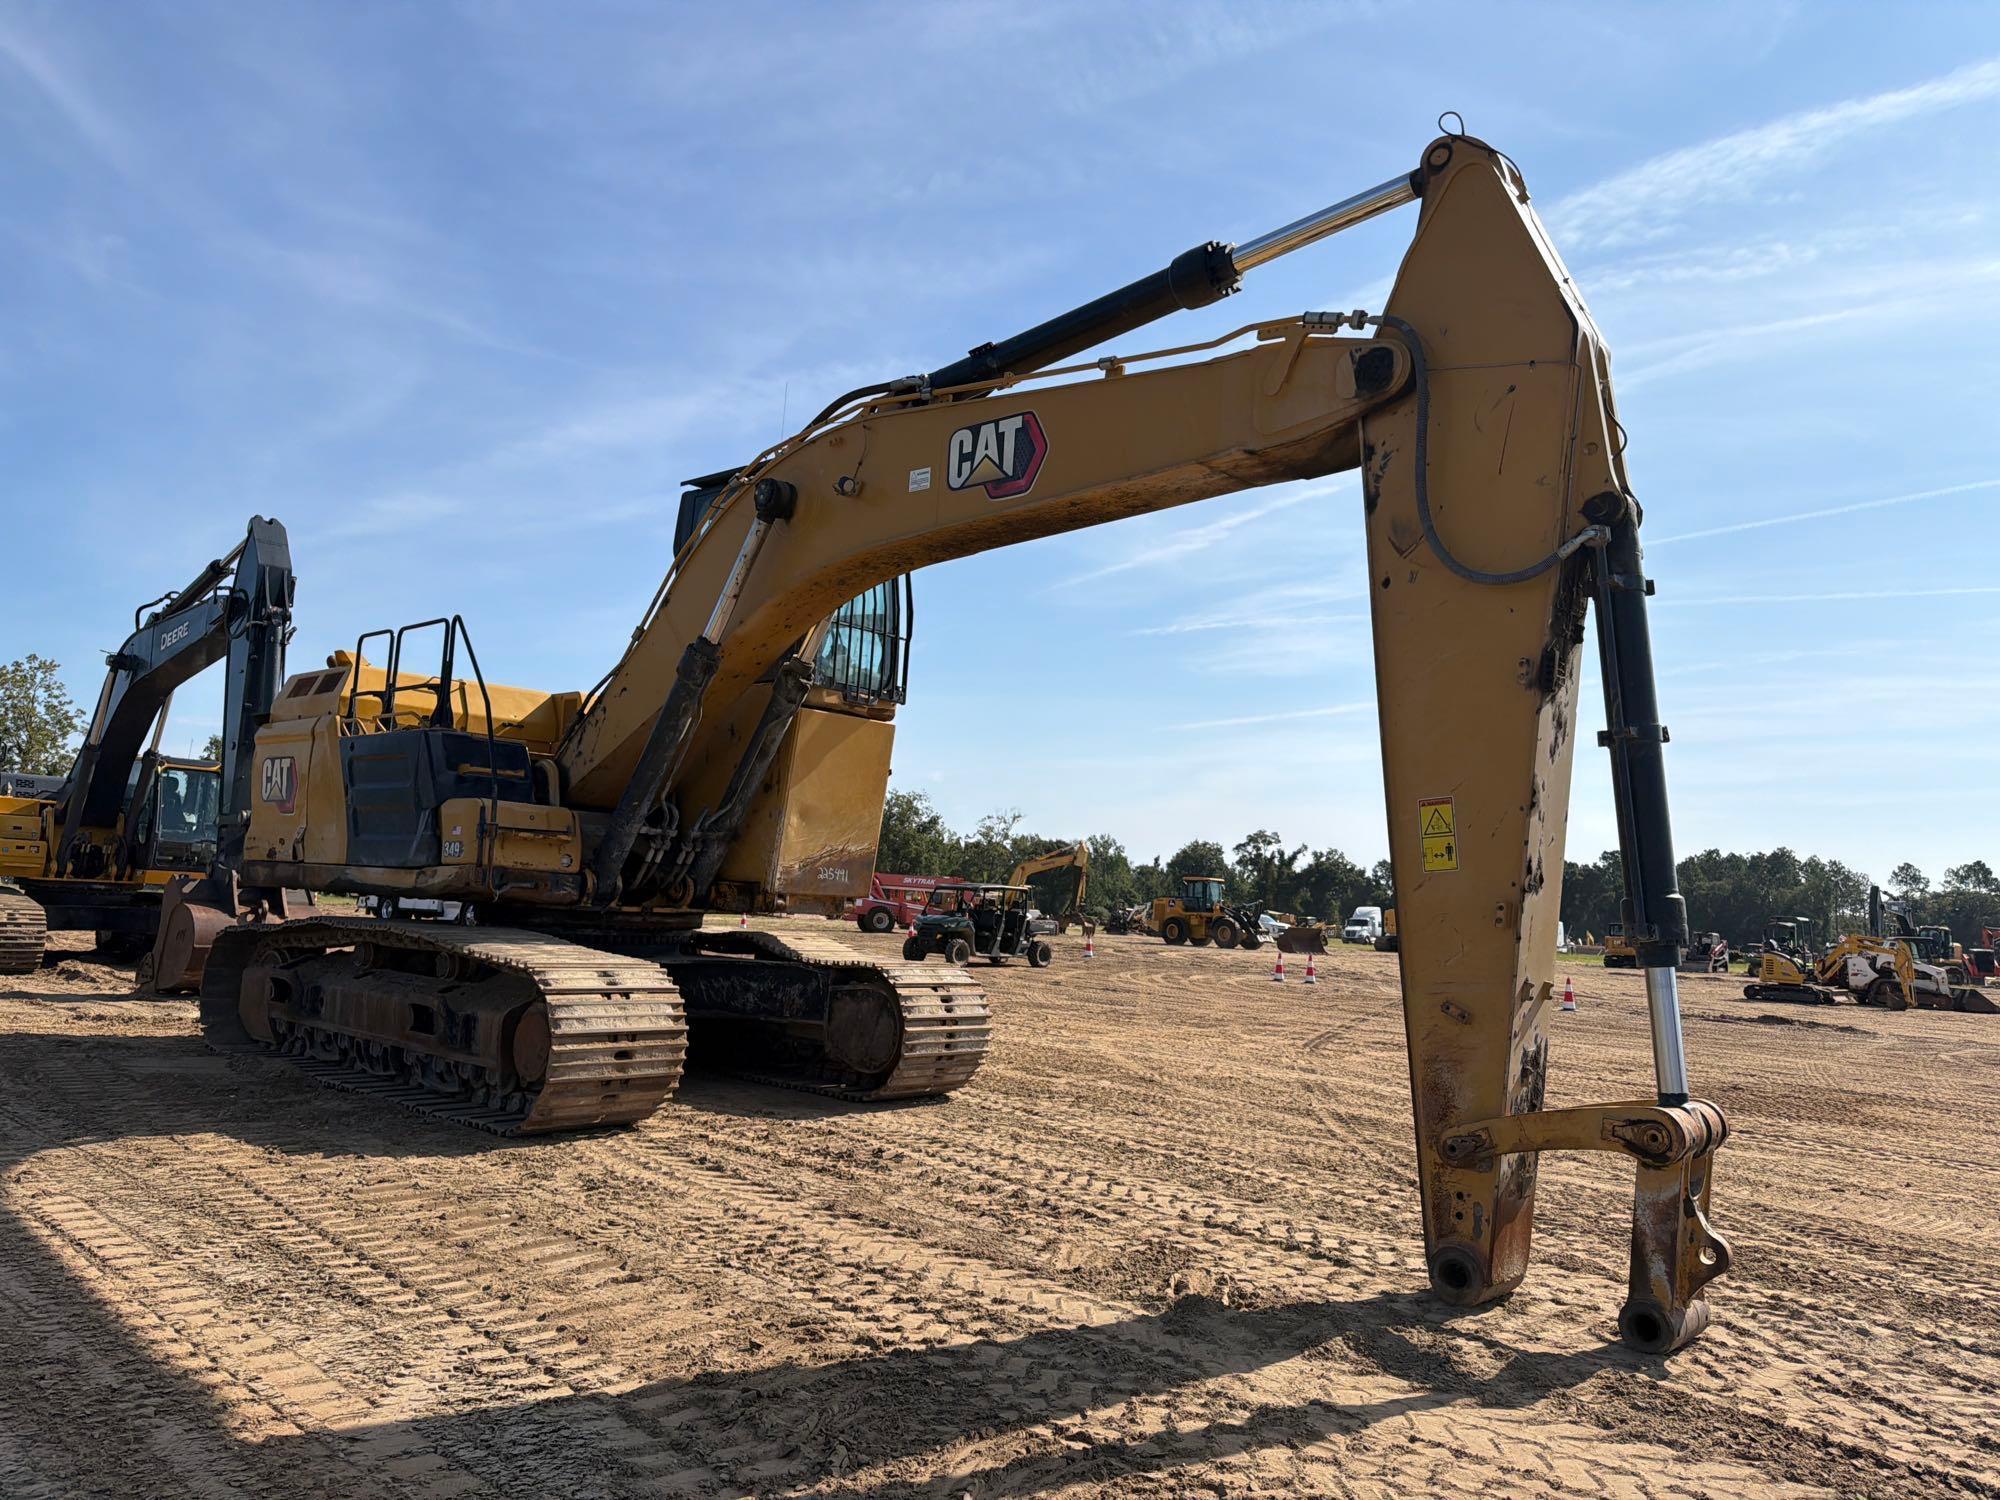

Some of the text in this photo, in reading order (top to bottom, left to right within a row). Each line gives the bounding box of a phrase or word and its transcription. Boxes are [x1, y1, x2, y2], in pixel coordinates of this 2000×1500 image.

[948, 415, 1023, 489] CAT
[160, 621, 189, 650] DEERE
[262, 758, 291, 801] CAT
[443, 841, 460, 857] 349
[903, 876, 936, 885] SKYTRAK
